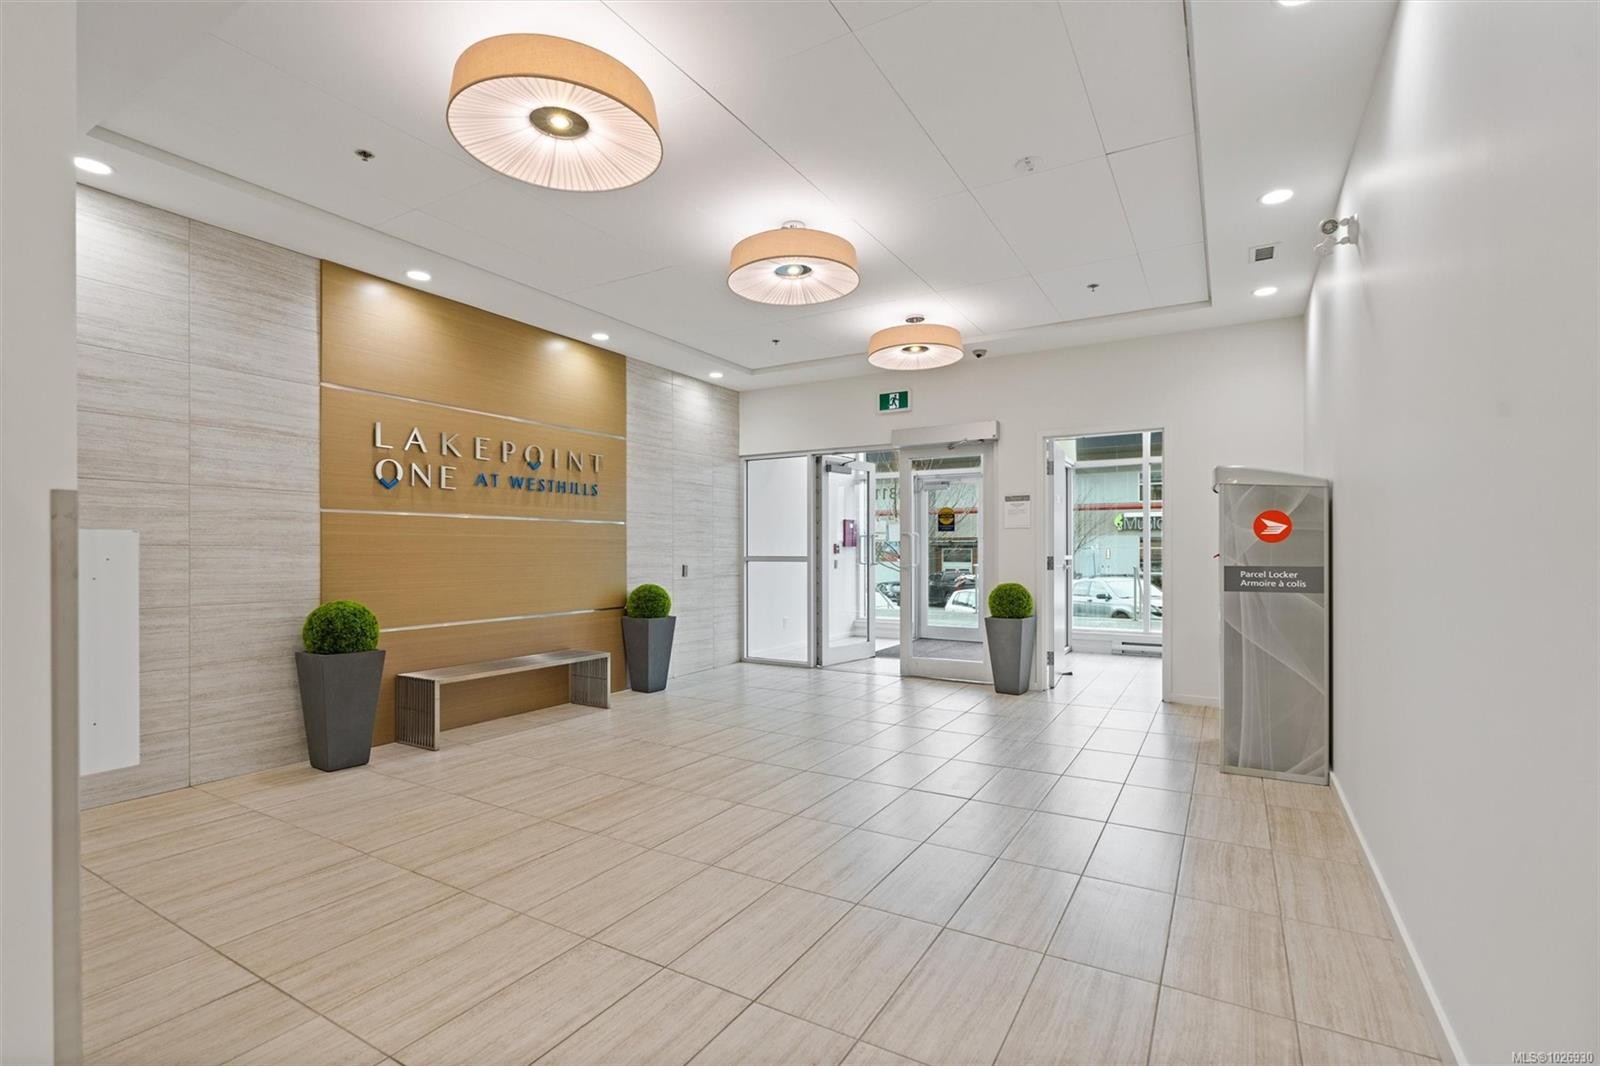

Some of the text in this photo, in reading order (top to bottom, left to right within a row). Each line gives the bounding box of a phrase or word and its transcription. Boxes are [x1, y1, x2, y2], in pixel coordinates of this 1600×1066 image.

[374, 421, 603, 473] LAKEPOINT
[375, 458, 599, 497] ONE AT WESTHILLS
[1240, 570, 1298, 579] Parcel Locker
[1240, 579, 1307, 588] Armoire à colis
